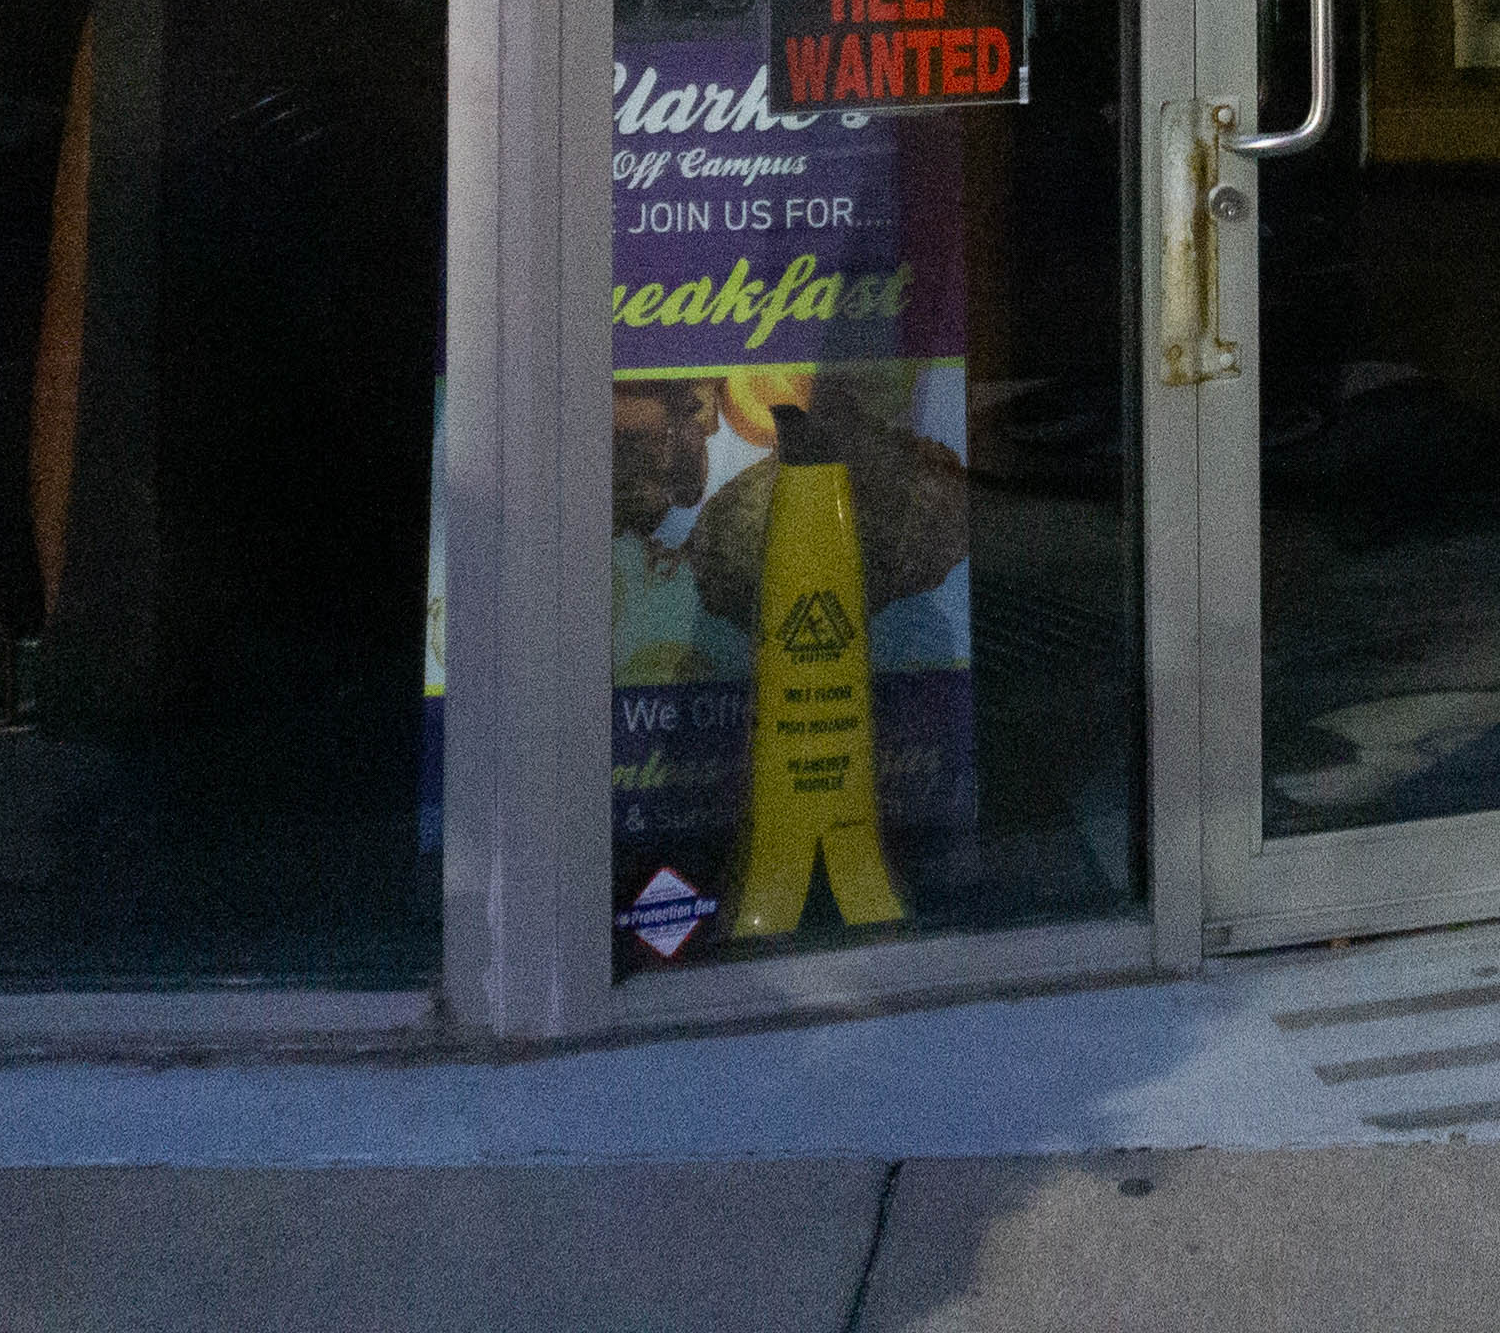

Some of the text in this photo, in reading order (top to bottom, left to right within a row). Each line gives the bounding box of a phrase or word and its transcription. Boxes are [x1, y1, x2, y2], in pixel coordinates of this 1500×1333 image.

[785, 26, 1011, 102] WANTED
[677, 148, 808, 186] Campus
[629, 202, 711, 233] JOIN
[724, 200, 772, 231] US
[622, 697, 678, 733] We
